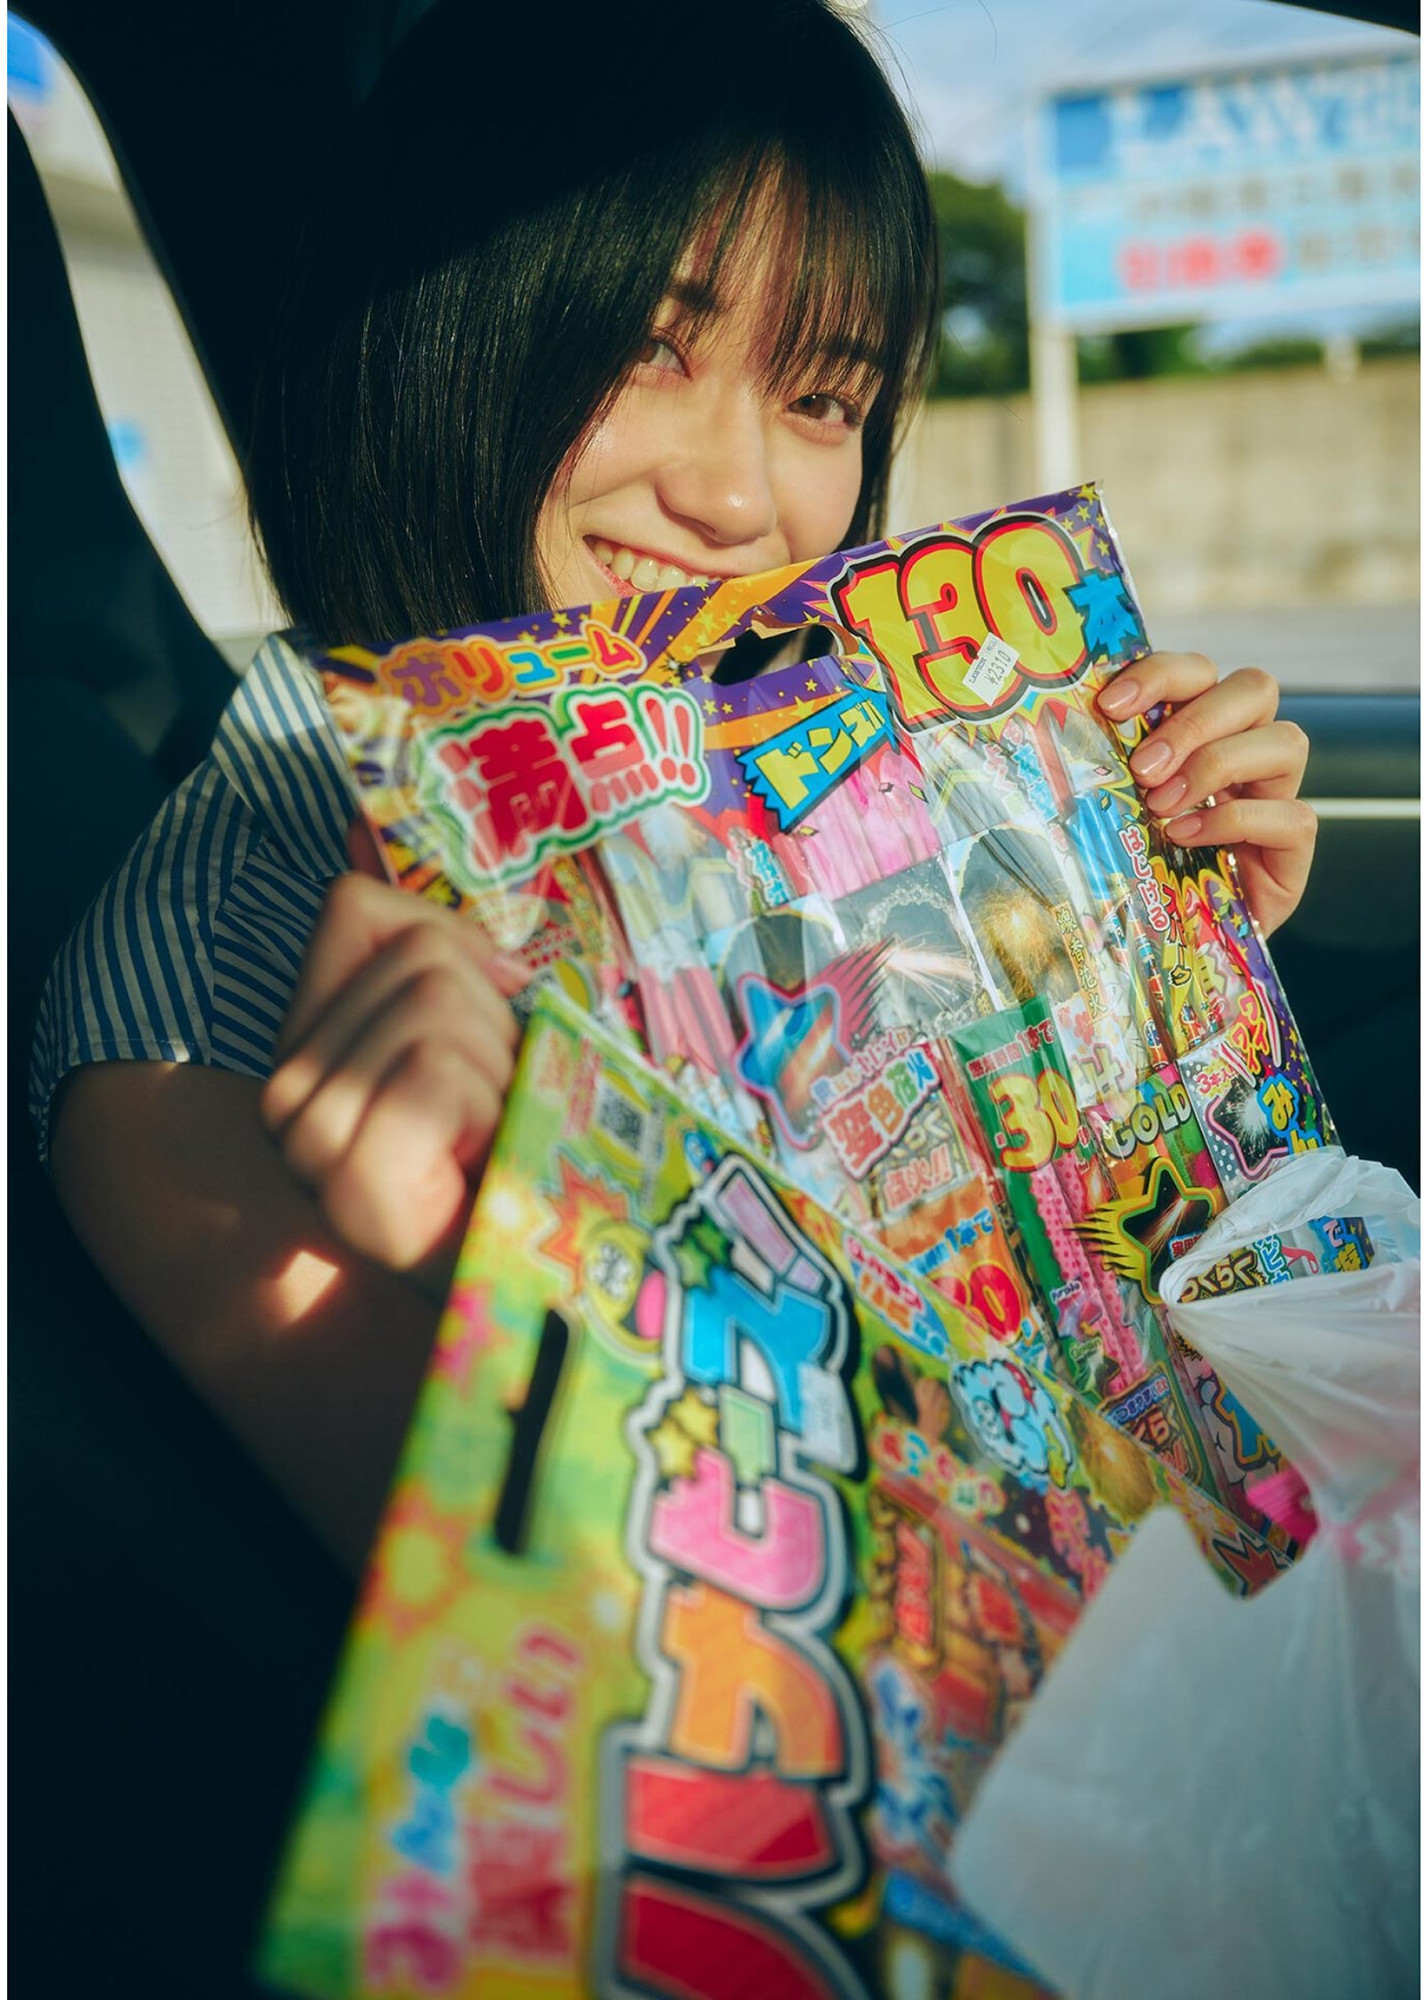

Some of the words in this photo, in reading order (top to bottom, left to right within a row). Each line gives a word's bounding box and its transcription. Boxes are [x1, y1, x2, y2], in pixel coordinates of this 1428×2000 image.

[388, 627, 637, 712] ボリューム
[832, 517, 1142, 733] 130本
[984, 650, 1012, 685] ¥2310
[437, 697, 698, 873] 満点!!
[1119, 827, 1170, 932] はじける
[1056, 906, 1108, 1020] 線香花火
[1104, 1081, 1192, 1160] GOLD
[465, 1622, 582, 1967] 楽しい
